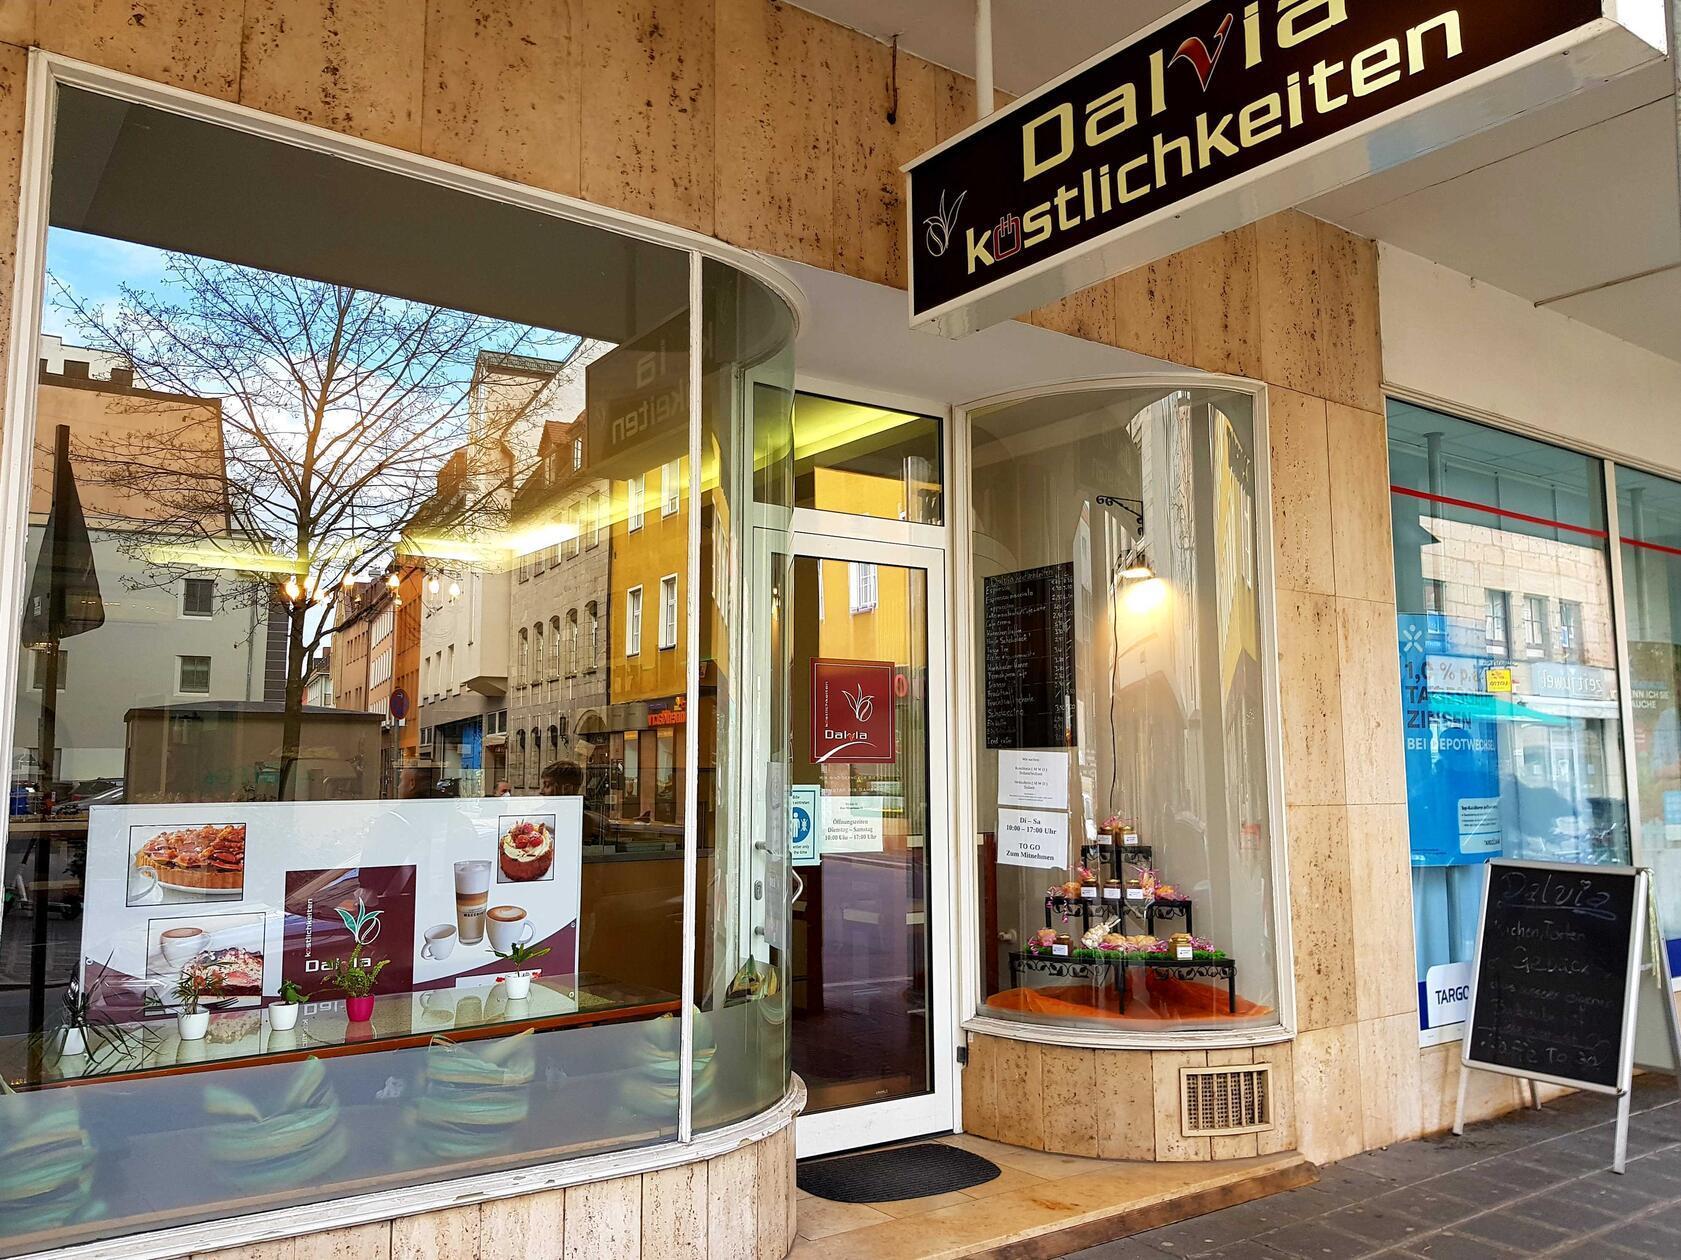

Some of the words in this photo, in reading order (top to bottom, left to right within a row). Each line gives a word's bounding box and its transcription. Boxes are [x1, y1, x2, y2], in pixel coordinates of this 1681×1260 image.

[824, 729, 868, 741] Dalvia
[1407, 738, 1427, 750] BEI
[1033, 817, 1041, 825] Sa
[1026, 826, 1043, 834] 17:00
[1029, 843, 1041, 851] GO
[1020, 851, 1055, 861] Mitnehmen
